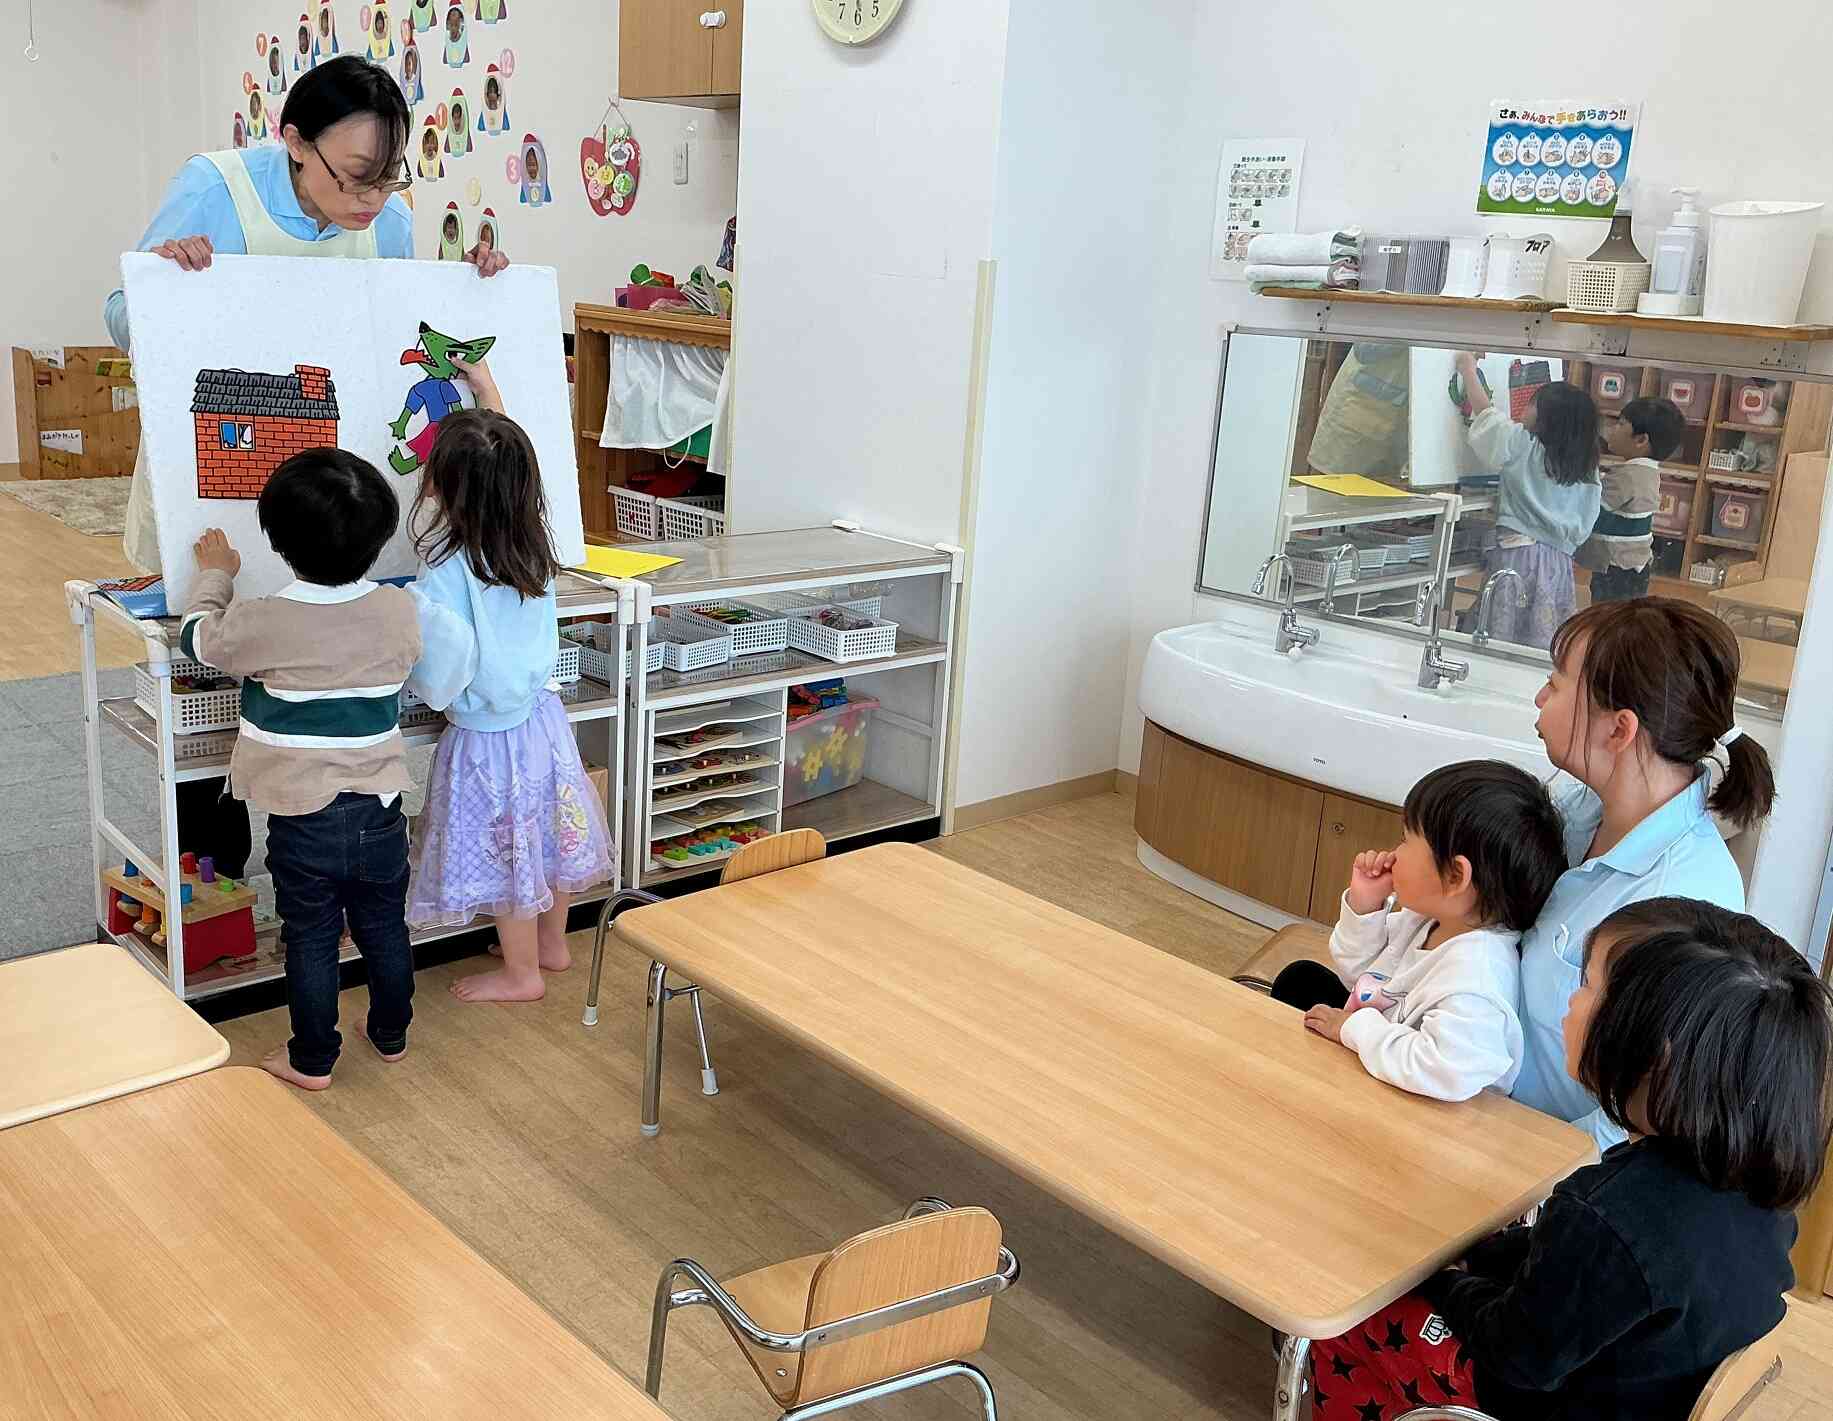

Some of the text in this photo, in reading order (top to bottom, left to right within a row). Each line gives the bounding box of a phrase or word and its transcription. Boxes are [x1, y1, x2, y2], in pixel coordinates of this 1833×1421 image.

[839, 3, 846, 20] 7
[854, 8, 862, 26] 6
[871, 0, 879, 18] 5
